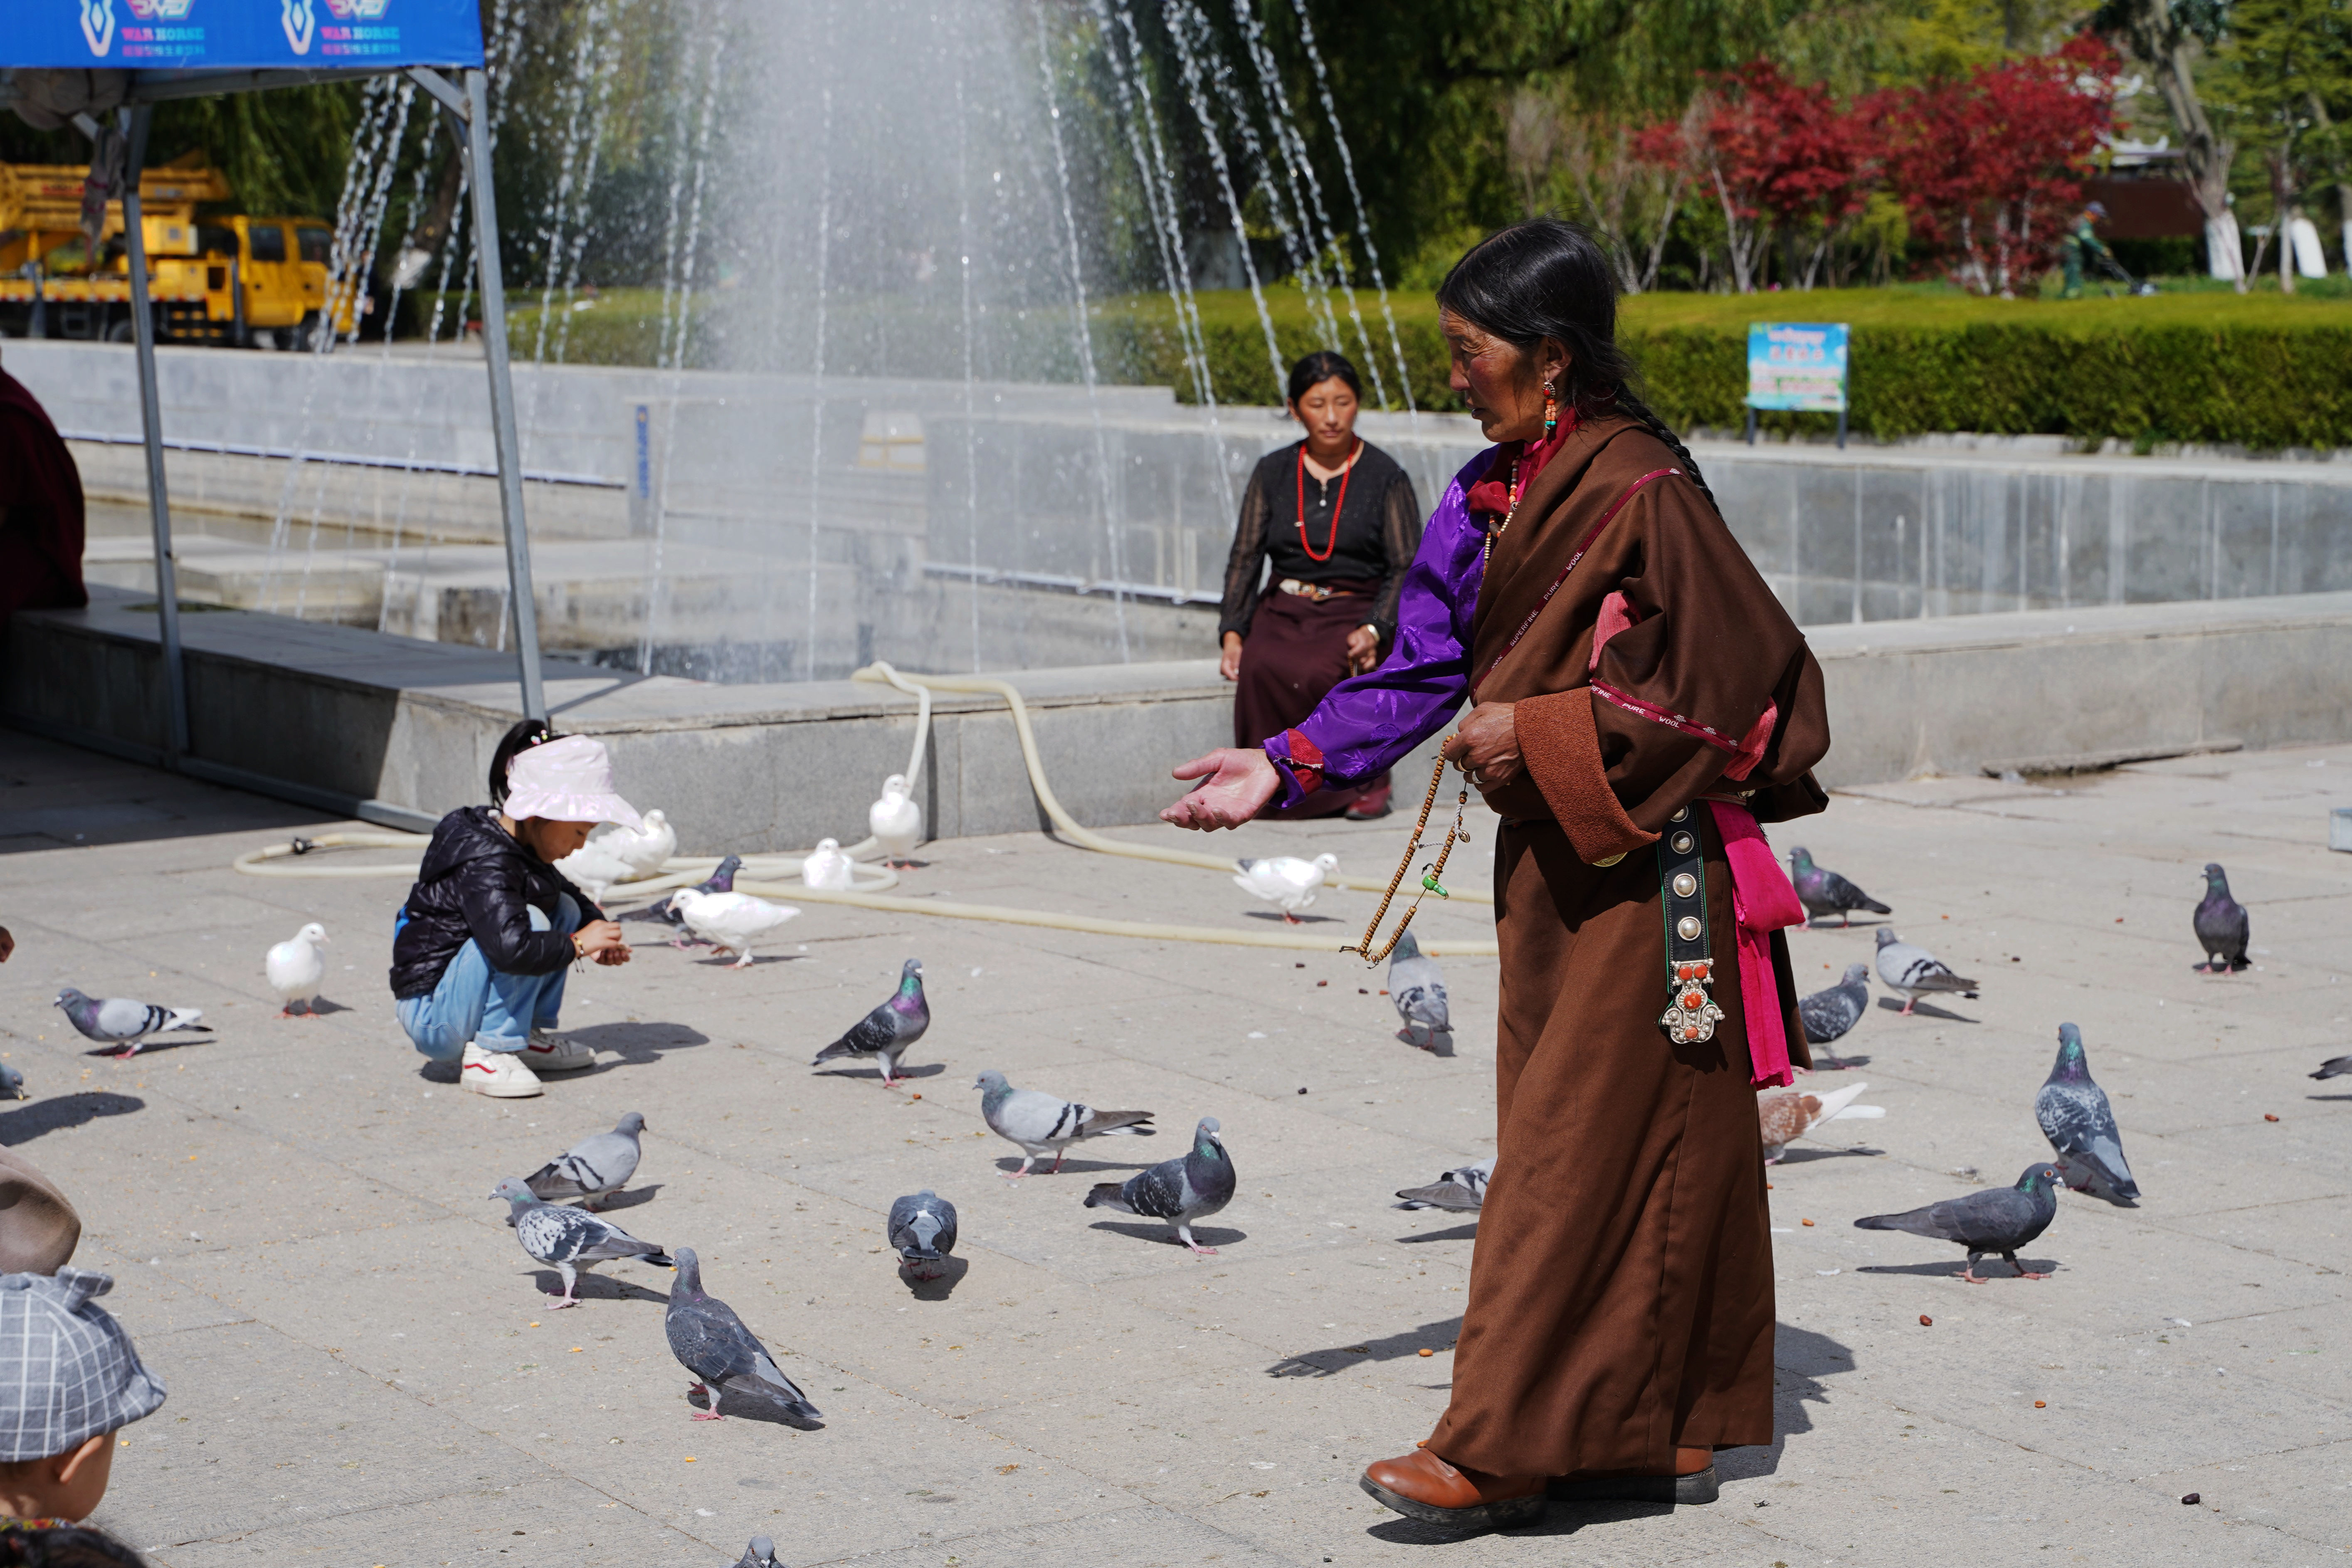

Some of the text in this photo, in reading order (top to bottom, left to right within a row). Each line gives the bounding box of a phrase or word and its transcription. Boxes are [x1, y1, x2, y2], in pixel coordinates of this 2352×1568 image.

[121, 27, 205, 41] WAR HORSE
[320, 26, 400, 40] WAR HORSE
[1510, 552, 1584, 647] SUPERFINE PURE WOOL
[1622, 703, 1646, 714] PURE
[1659, 716, 1680, 728] WOOL
